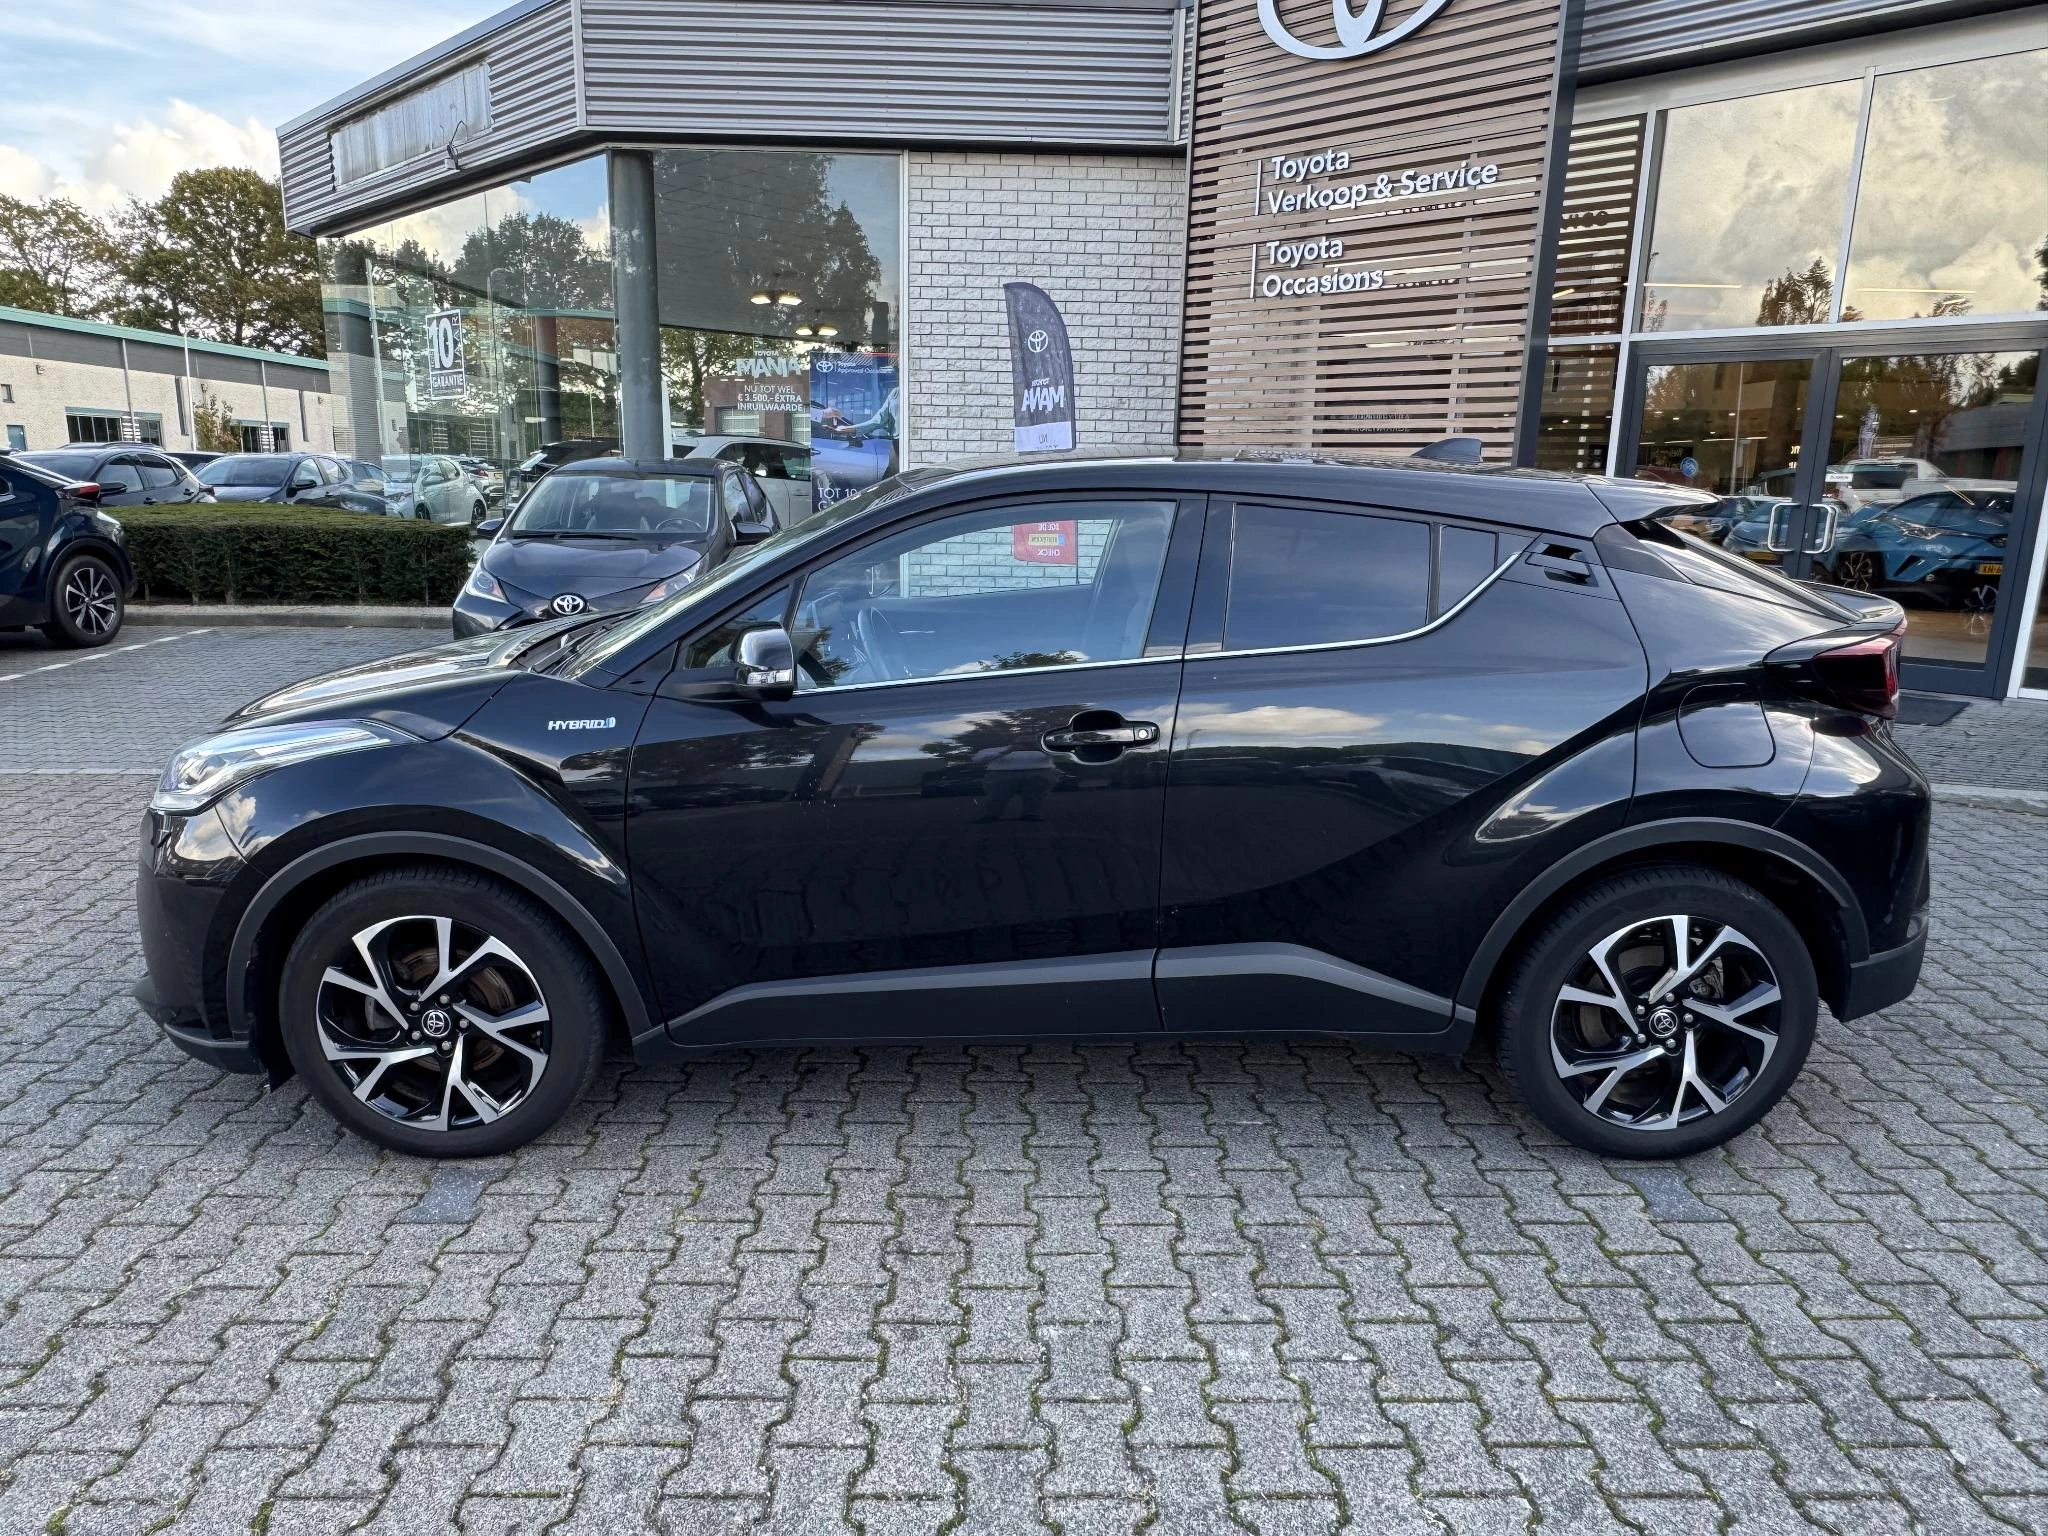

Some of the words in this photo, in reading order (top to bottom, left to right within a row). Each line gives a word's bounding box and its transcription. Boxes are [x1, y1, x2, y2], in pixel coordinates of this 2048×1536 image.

[1271, 149, 1349, 182] Toyota
[1268, 184, 1368, 215] Verkoop
[1373, 174, 1393, 199] &
[1400, 161, 1499, 196] Service
[1266, 236, 1343, 268] Toyota
[1263, 267, 1384, 297] Occasions
[428, 317, 454, 369] 10
[735, 356, 802, 379] MANIA
[432, 373, 463, 388] GARANTIE
[744, 385, 758, 393] NU
[760, 385, 776, 394] TOT
[777, 386, 796, 394] WEL
[737, 402, 804, 412] INRUILWAARDE
[818, 487, 841, 498] TOT
[548, 720, 604, 730] HYBRID
